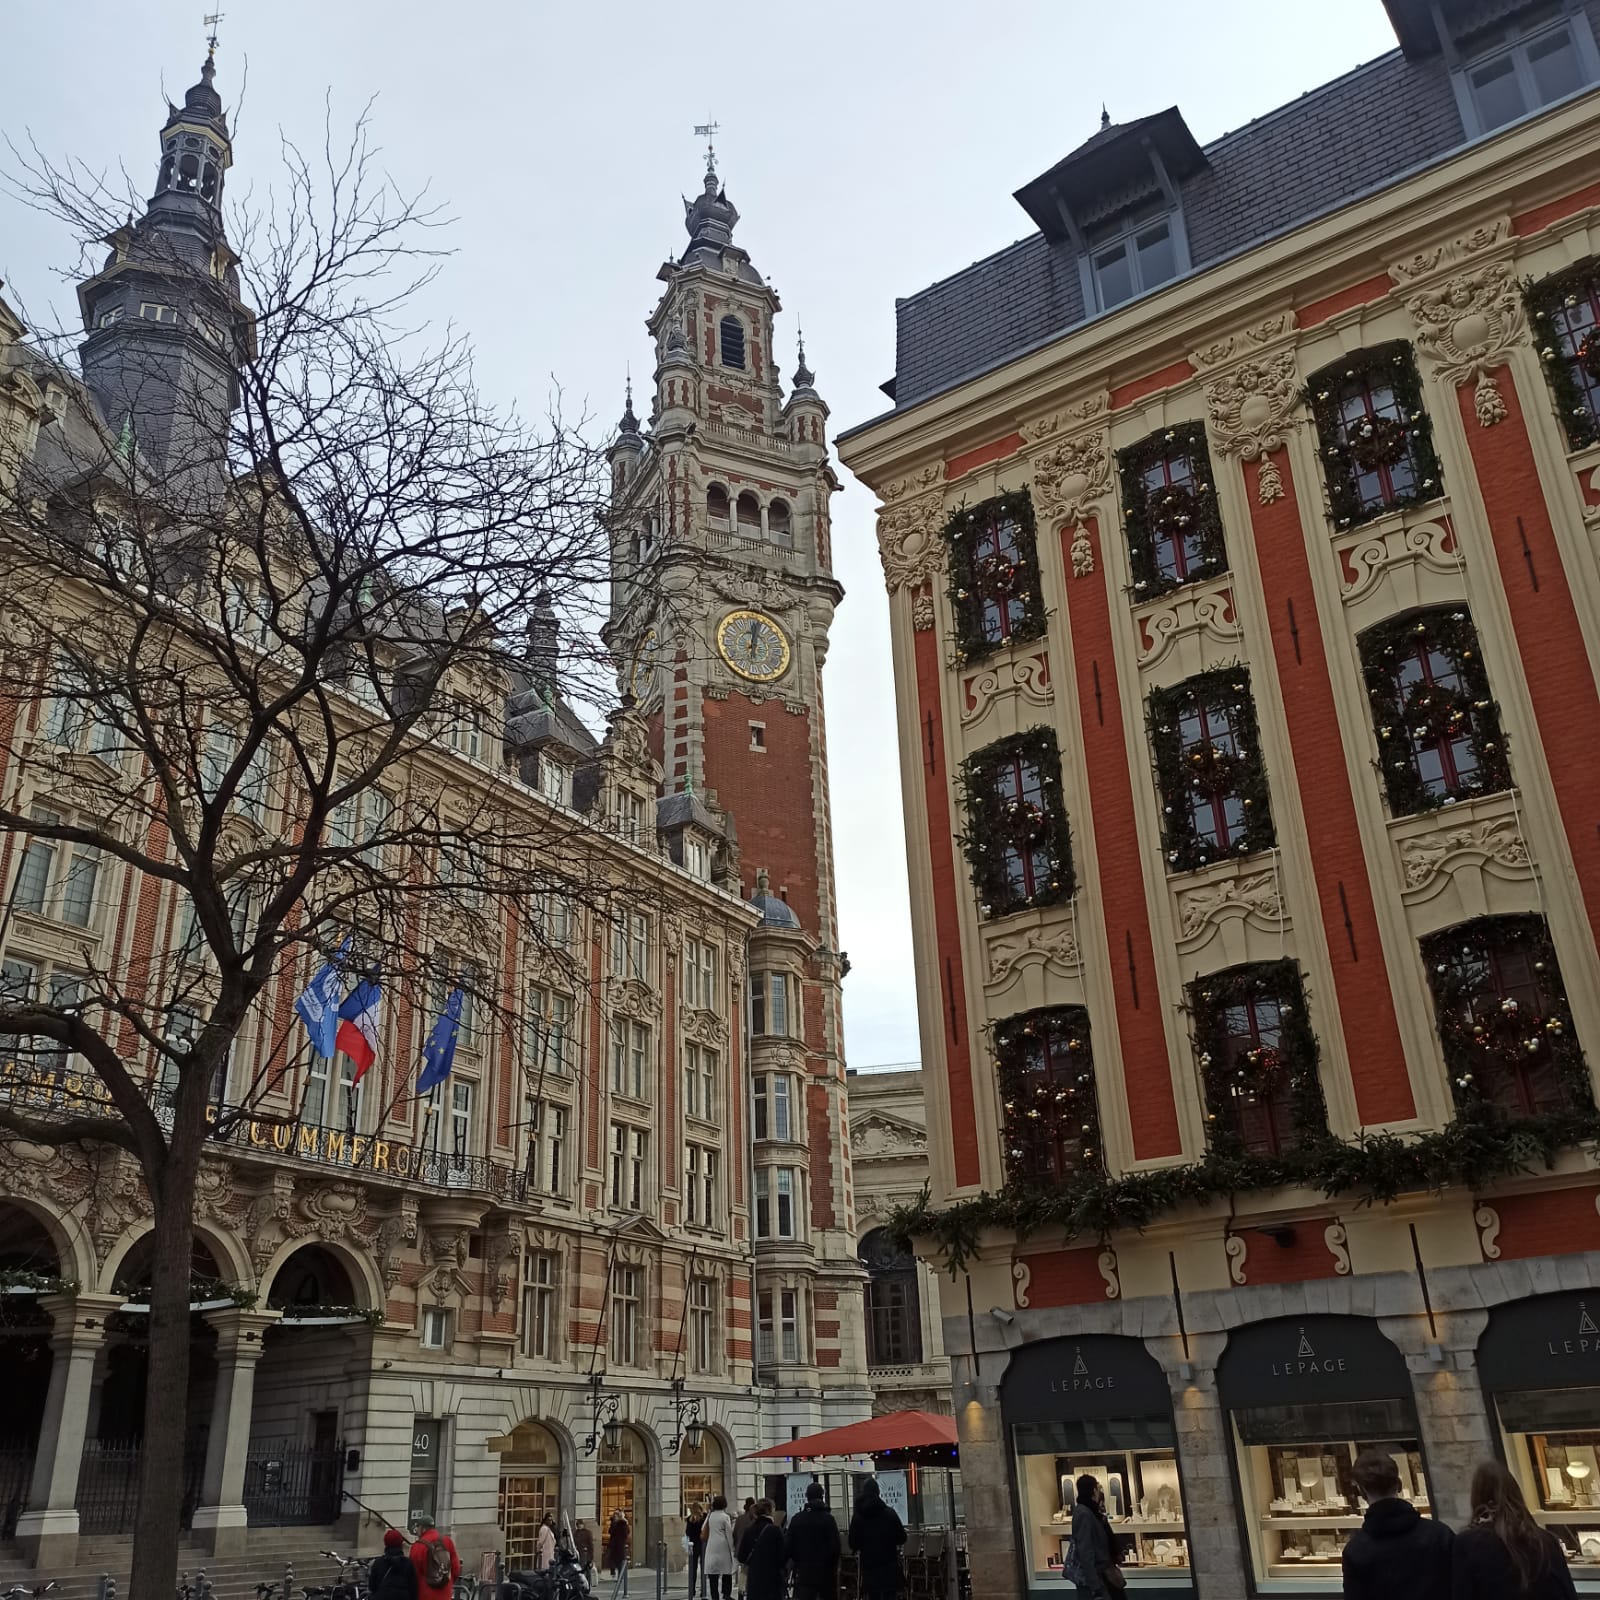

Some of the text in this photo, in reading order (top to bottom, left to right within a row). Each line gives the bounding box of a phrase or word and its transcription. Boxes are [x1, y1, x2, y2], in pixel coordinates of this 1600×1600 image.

[1272, 1358, 1346, 1376] LEPAGE
[1051, 1376, 1115, 1392] LEPAGE
[414, 1433, 429, 1450] 40
